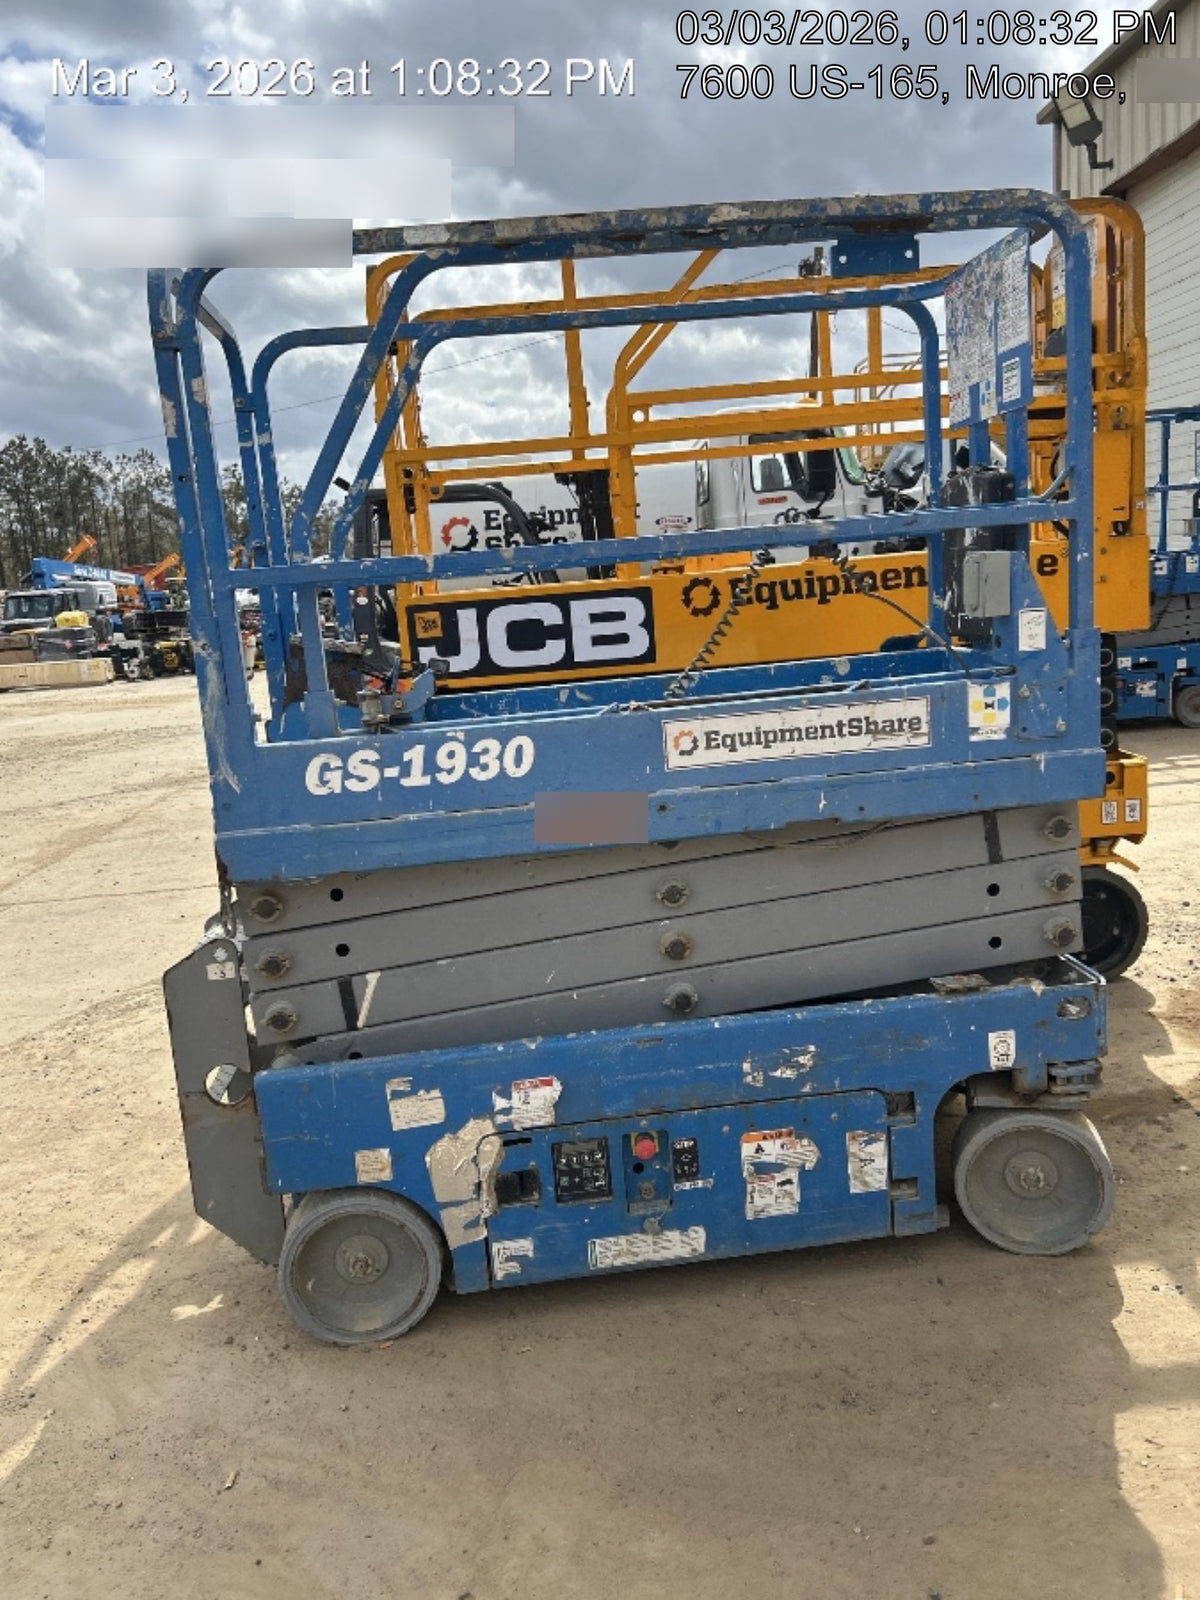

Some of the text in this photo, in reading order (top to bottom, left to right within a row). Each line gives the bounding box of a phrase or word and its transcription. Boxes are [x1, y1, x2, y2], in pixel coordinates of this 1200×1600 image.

[418, 596, 650, 673] JCB
[704, 715, 923, 752] EquipmentShare
[305, 735, 535, 796] GS-1930
